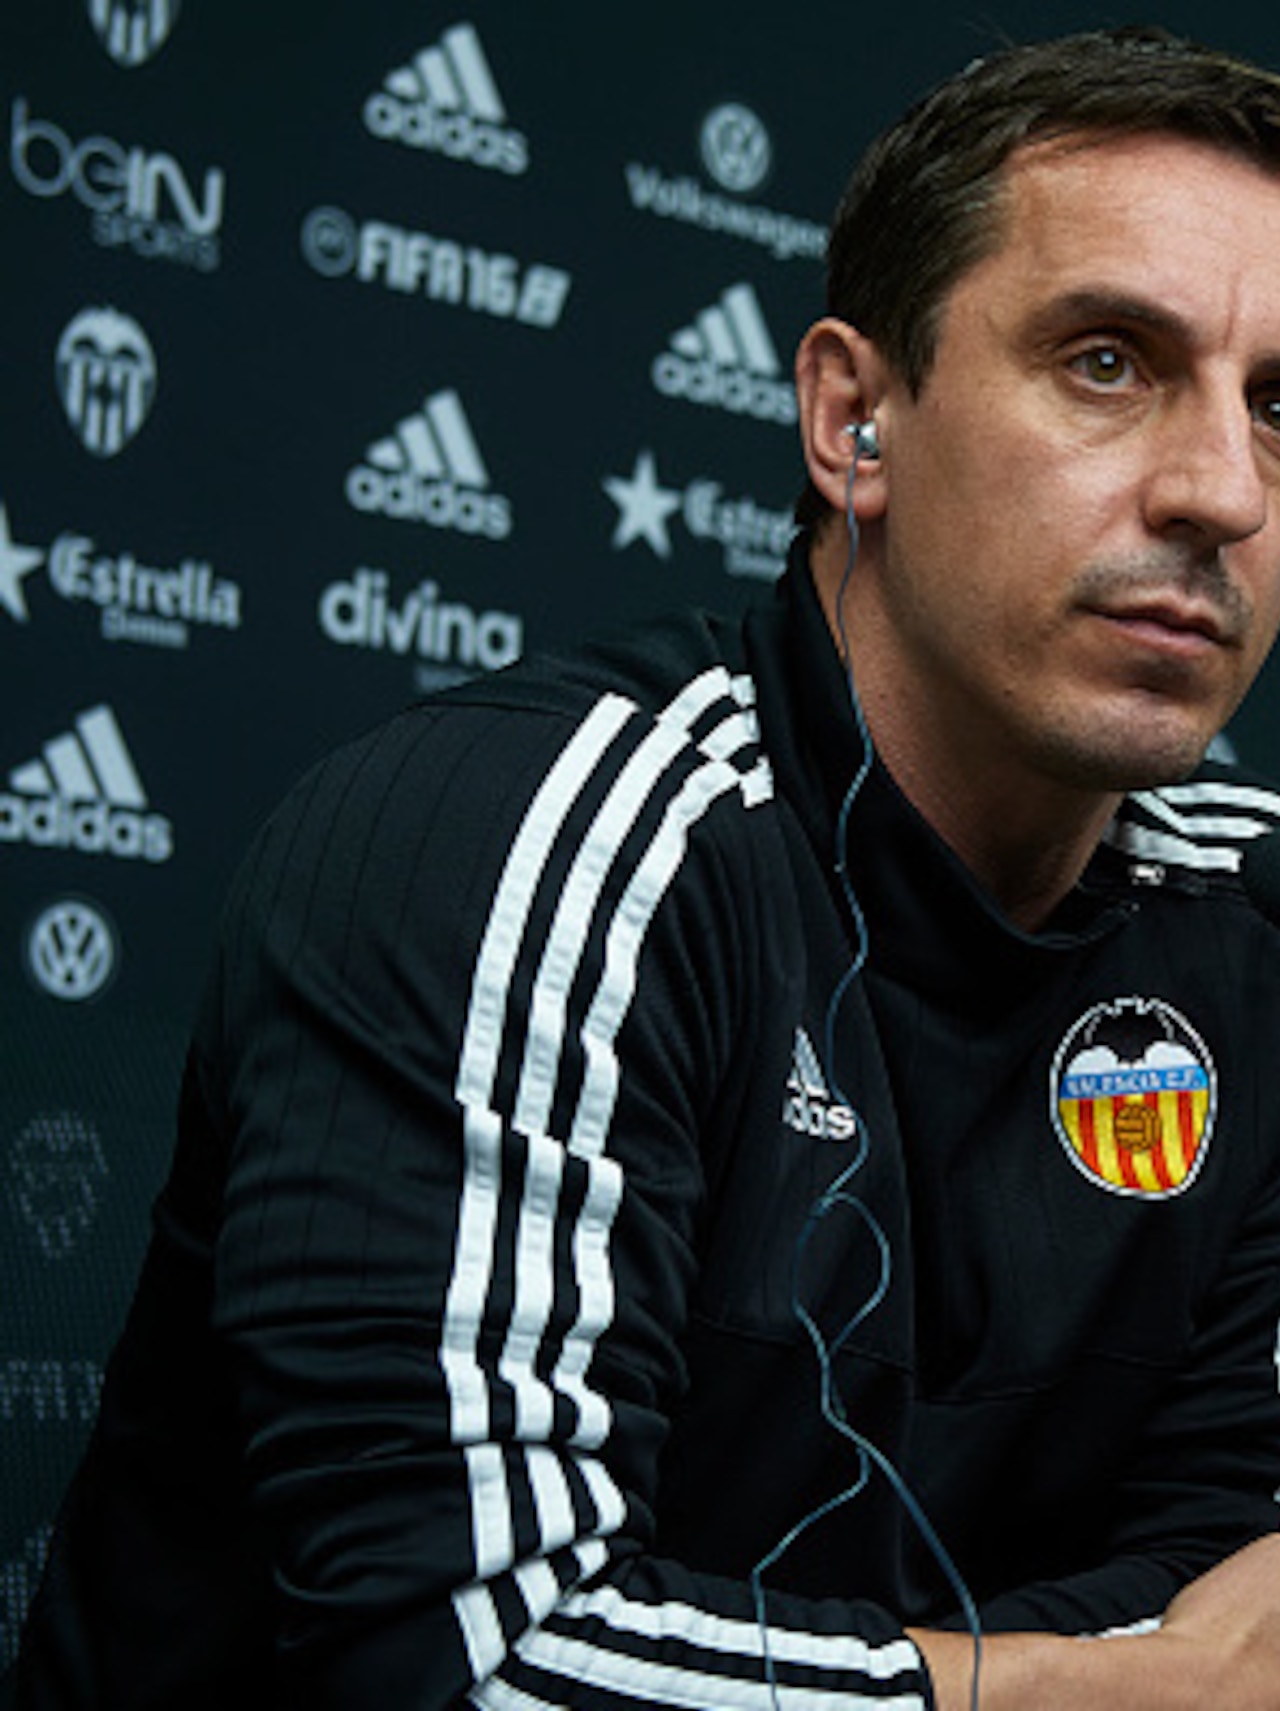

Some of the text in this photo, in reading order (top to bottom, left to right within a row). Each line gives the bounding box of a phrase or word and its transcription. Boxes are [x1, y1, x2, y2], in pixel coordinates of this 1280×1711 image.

[362, 91, 531, 176] adidas
[345, 463, 513, 542] adidas
[47, 529, 242, 629] Estrella
[317, 564, 524, 674] divina
